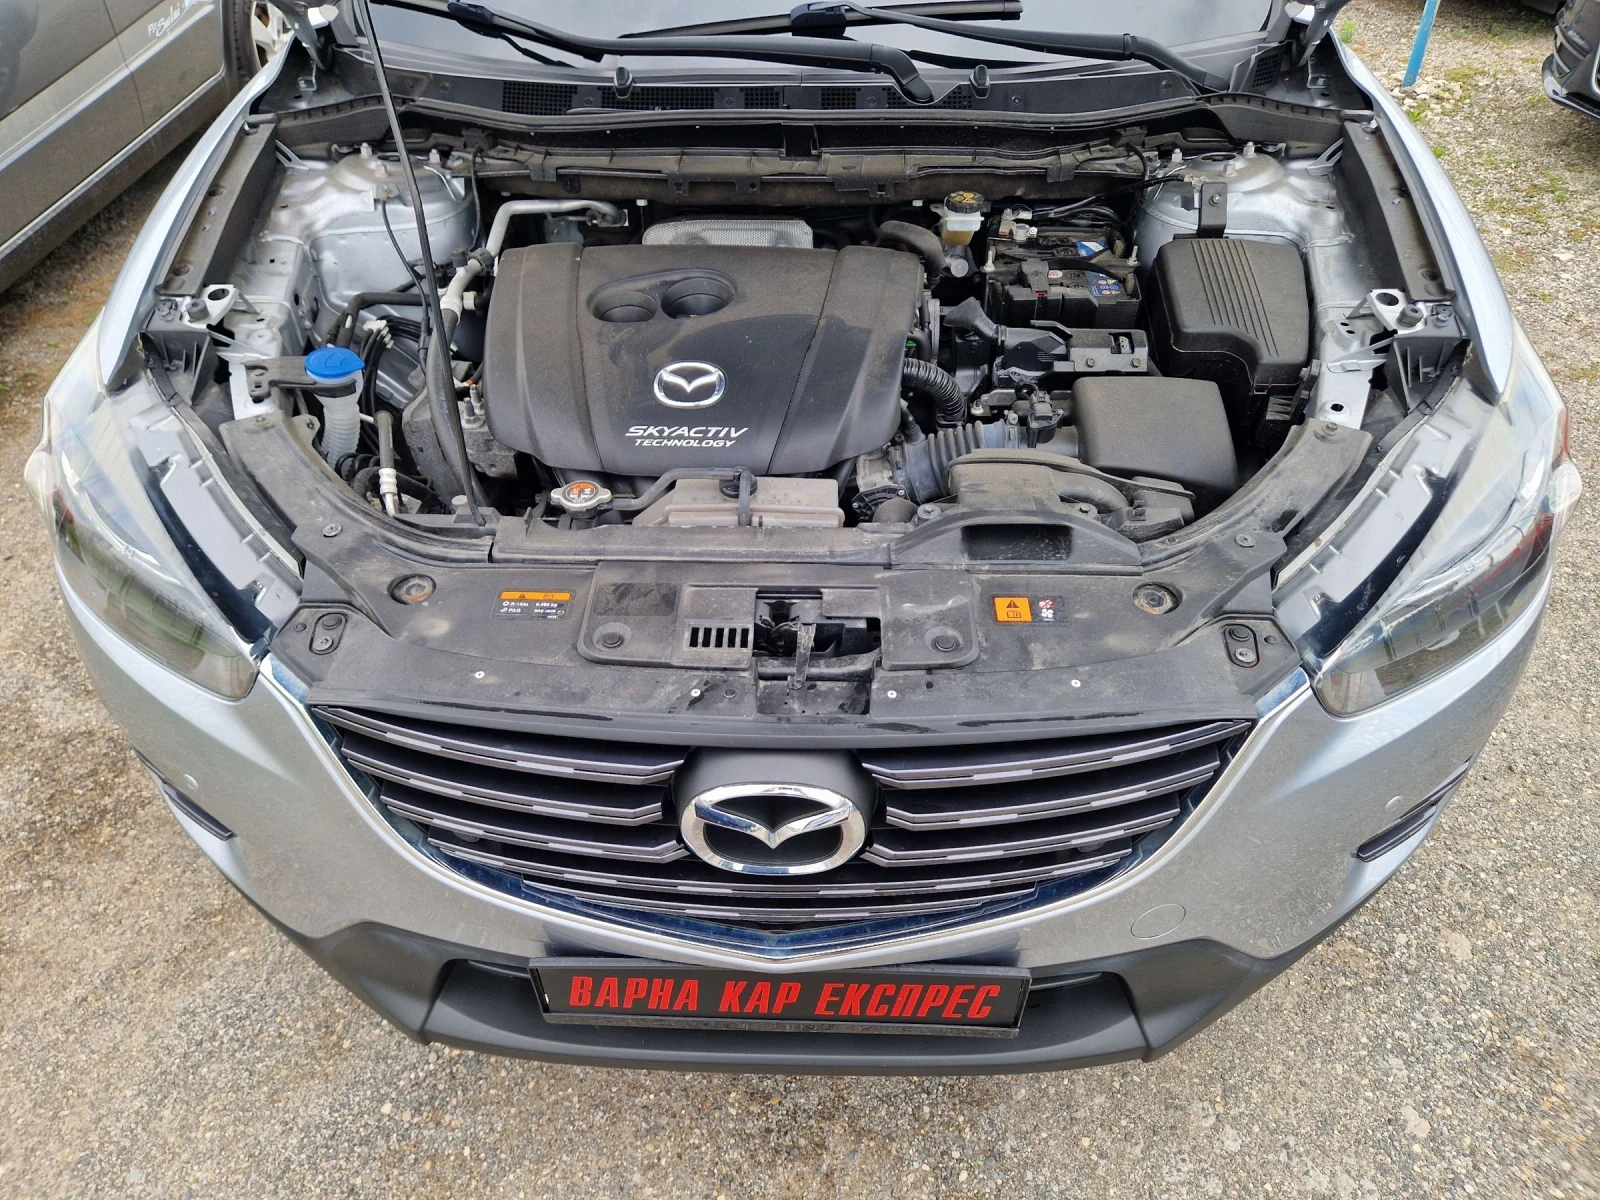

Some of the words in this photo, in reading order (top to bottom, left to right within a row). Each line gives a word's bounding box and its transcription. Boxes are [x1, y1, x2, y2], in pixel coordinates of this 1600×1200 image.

[625, 425, 749, 438] SKYACTIV
[634, 438, 737, 448] TECHNOLOGY
[568, 975, 699, 1012] ВАРНА
[718, 979, 802, 1015] КАР
[814, 982, 1001, 1019] ЕКСПРЕС
